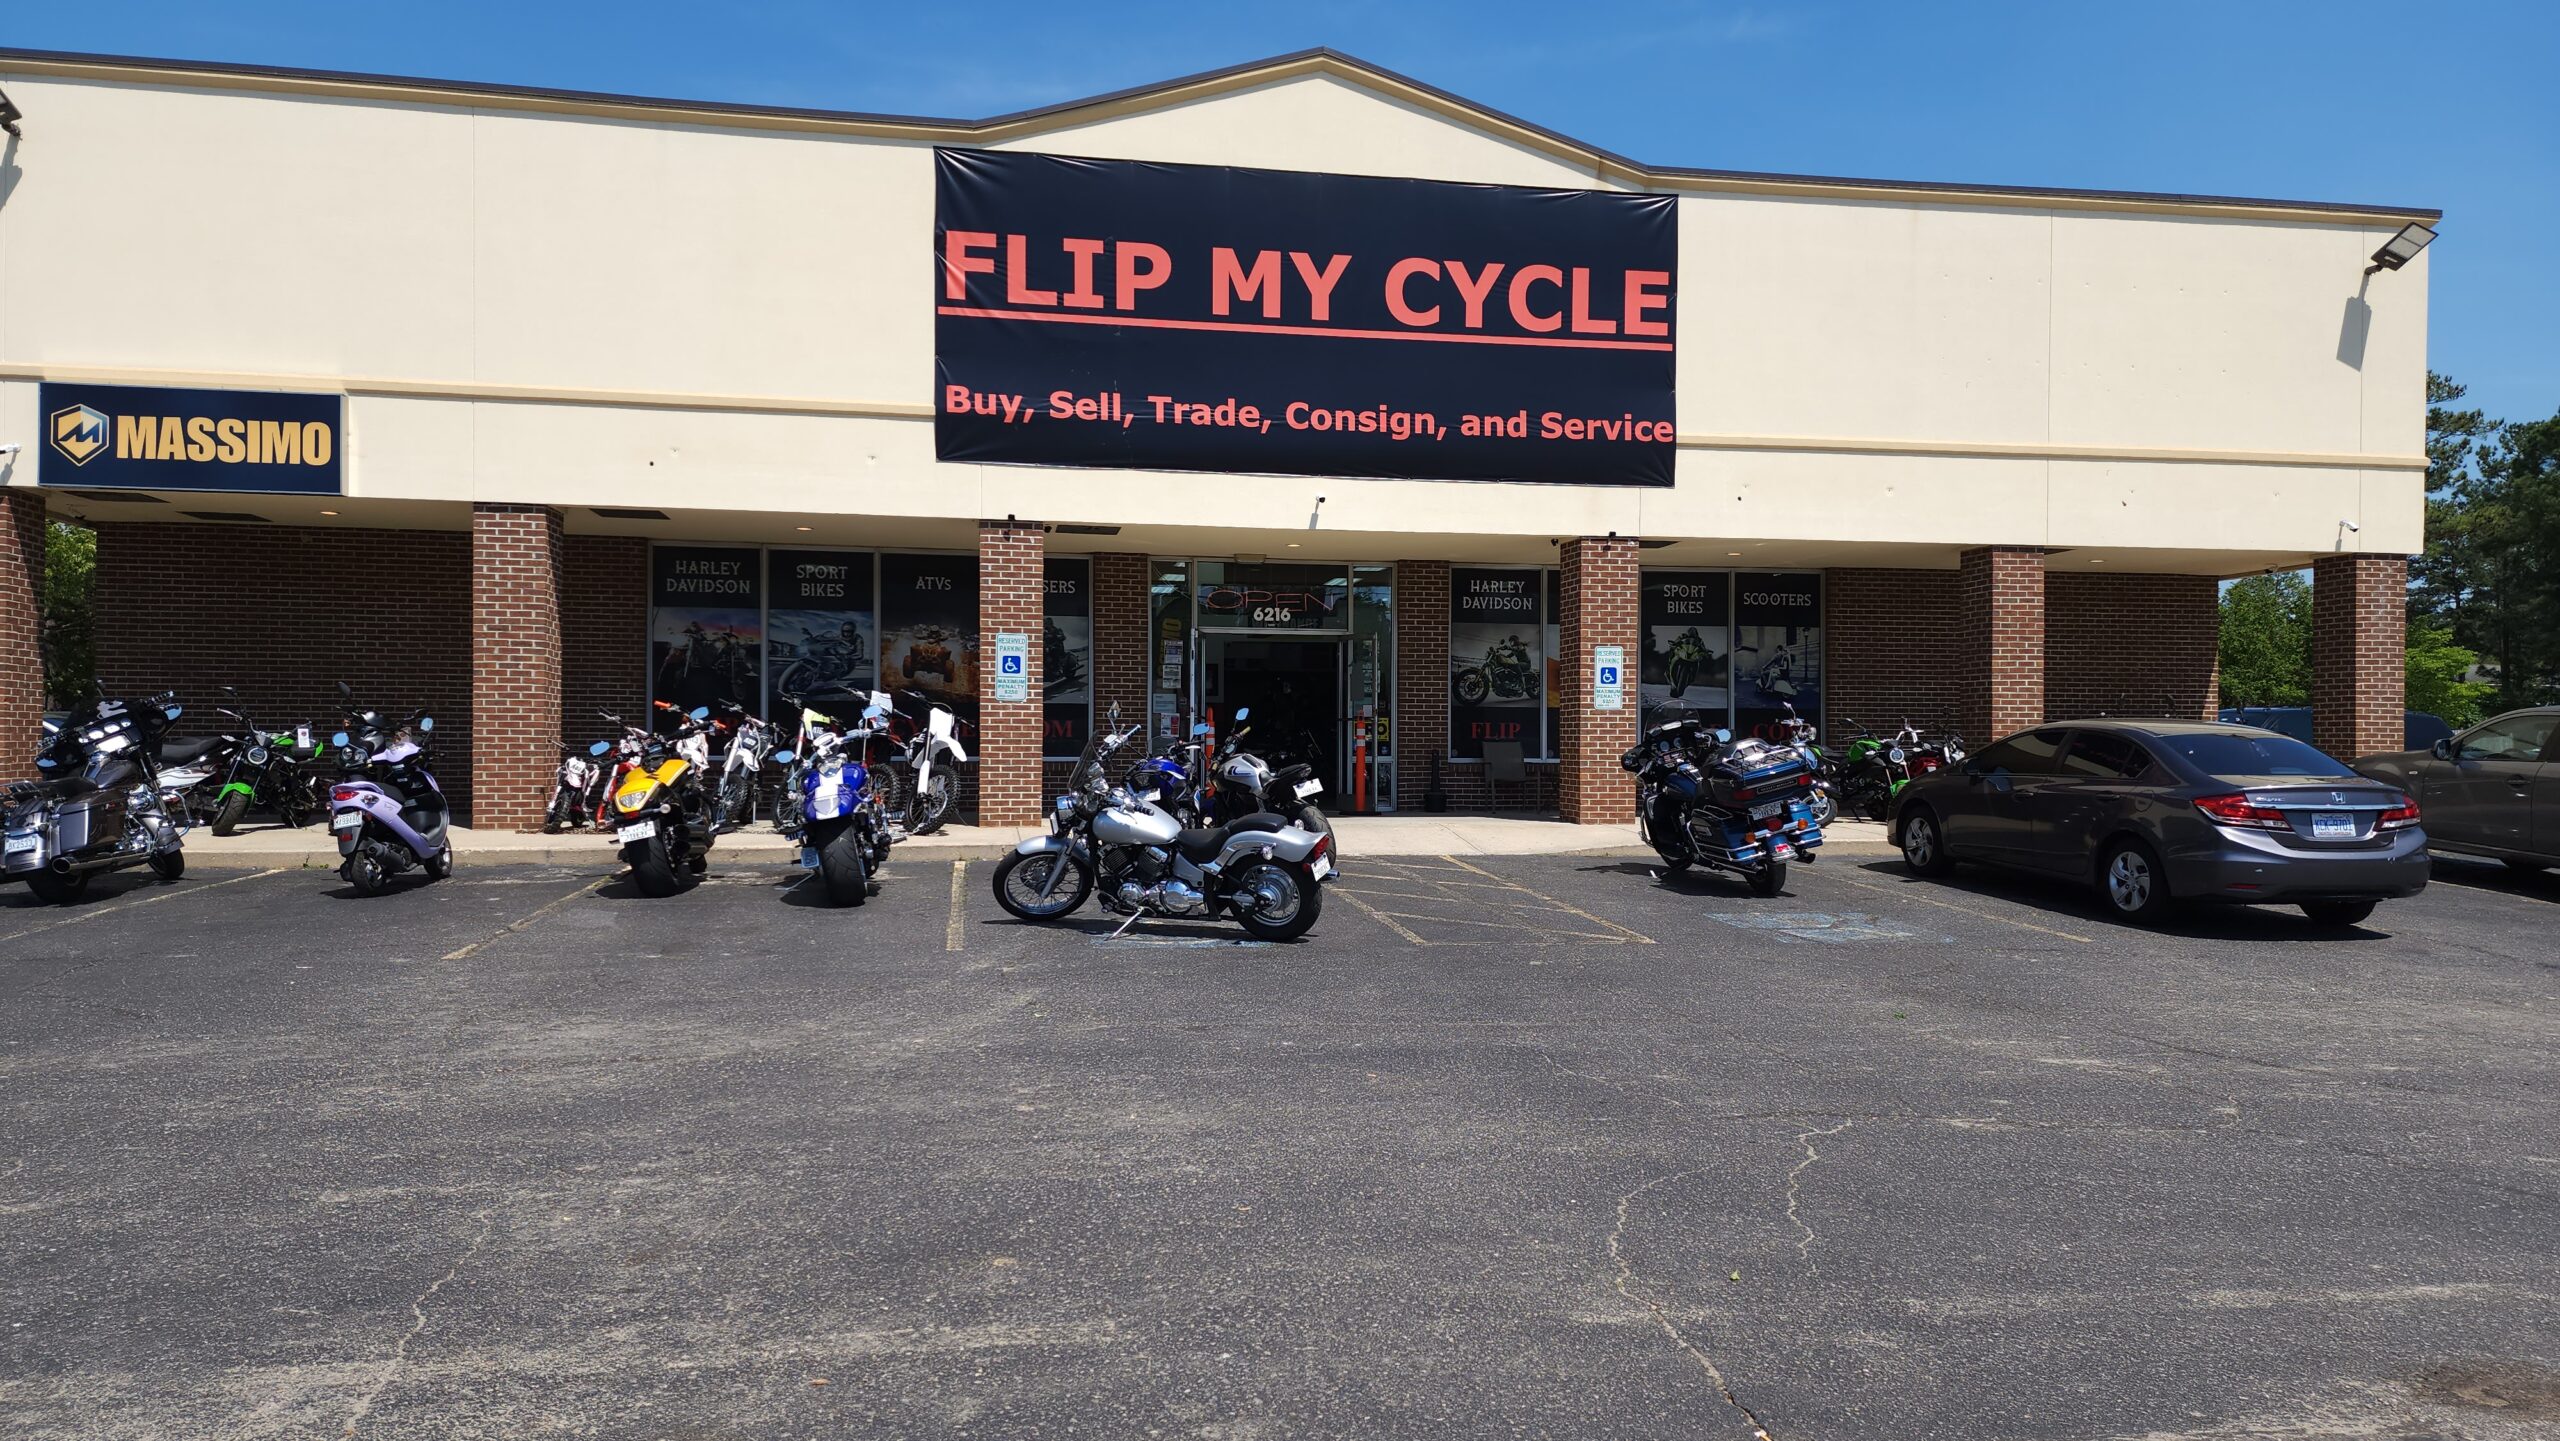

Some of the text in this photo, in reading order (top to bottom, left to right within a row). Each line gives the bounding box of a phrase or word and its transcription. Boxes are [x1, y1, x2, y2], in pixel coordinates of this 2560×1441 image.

[946, 231, 1668, 335] FLIP MY CYCLE
[947, 385, 1673, 442] Buy, Sell, Trade, Consign, and Service
[117, 415, 332, 466] MASSIMO
[675, 560, 741, 576] HARLEY
[796, 564, 849, 580] SPORT
[666, 578, 751, 594] DAVIDSON
[801, 583, 845, 598] BIKES
[915, 576, 952, 591] ATVs
[1043, 580, 1076, 594] SERS
[1470, 580, 1526, 594] HARLEY
[1663, 584, 1707, 598] SPORT
[1207, 589, 1334, 613] OPEN
[1463, 596, 1533, 610] DAVIDSON
[1743, 592, 1812, 606] SCOOTERS
[1253, 607, 1292, 622] 6216
[1667, 601, 1704, 614] BIKES
[998, 637, 1026, 645] RESERVED
[1471, 722, 1521, 740] FLIP
